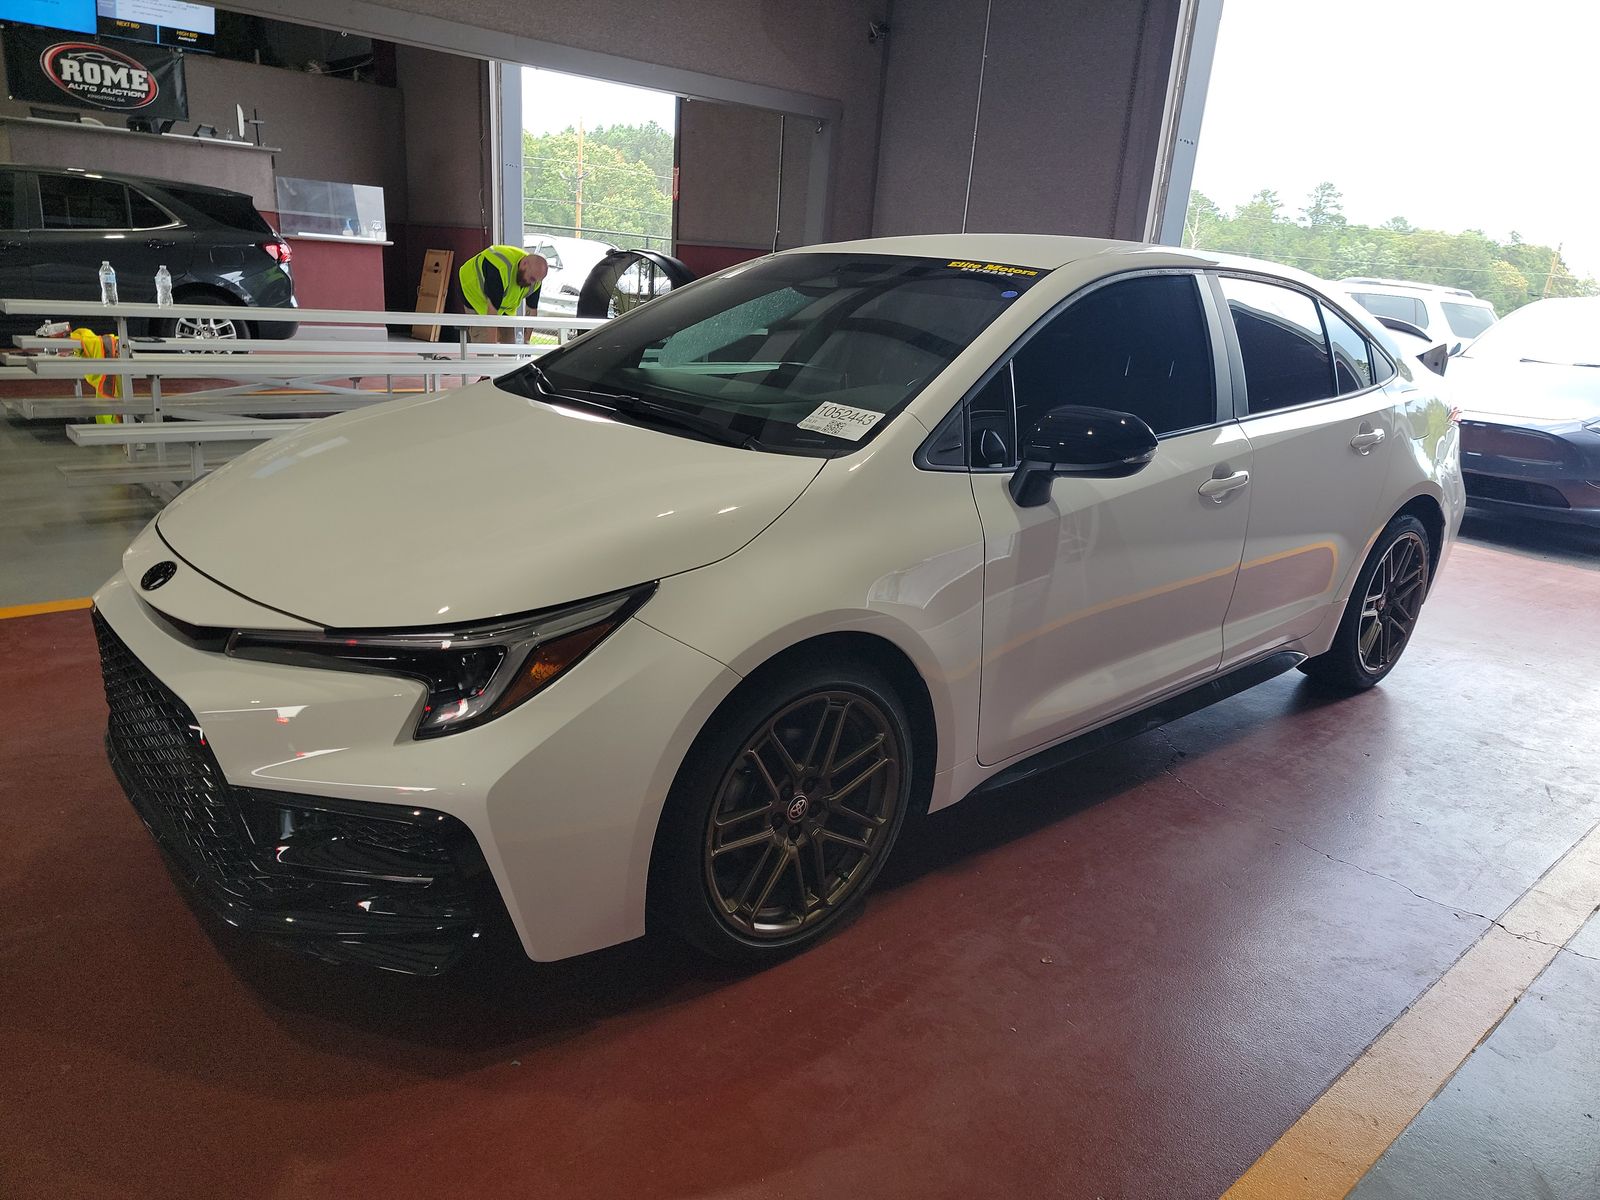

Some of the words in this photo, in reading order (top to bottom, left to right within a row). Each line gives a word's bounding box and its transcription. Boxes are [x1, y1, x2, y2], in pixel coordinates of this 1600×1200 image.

[60, 58, 149, 91] ROME
[67, 83, 98, 92] AUTO
[101, 87, 146, 98] AUCTION
[947, 261, 982, 269] Elite
[983, 264, 1038, 276] Motors
[818, 405, 876, 426] 1052443
